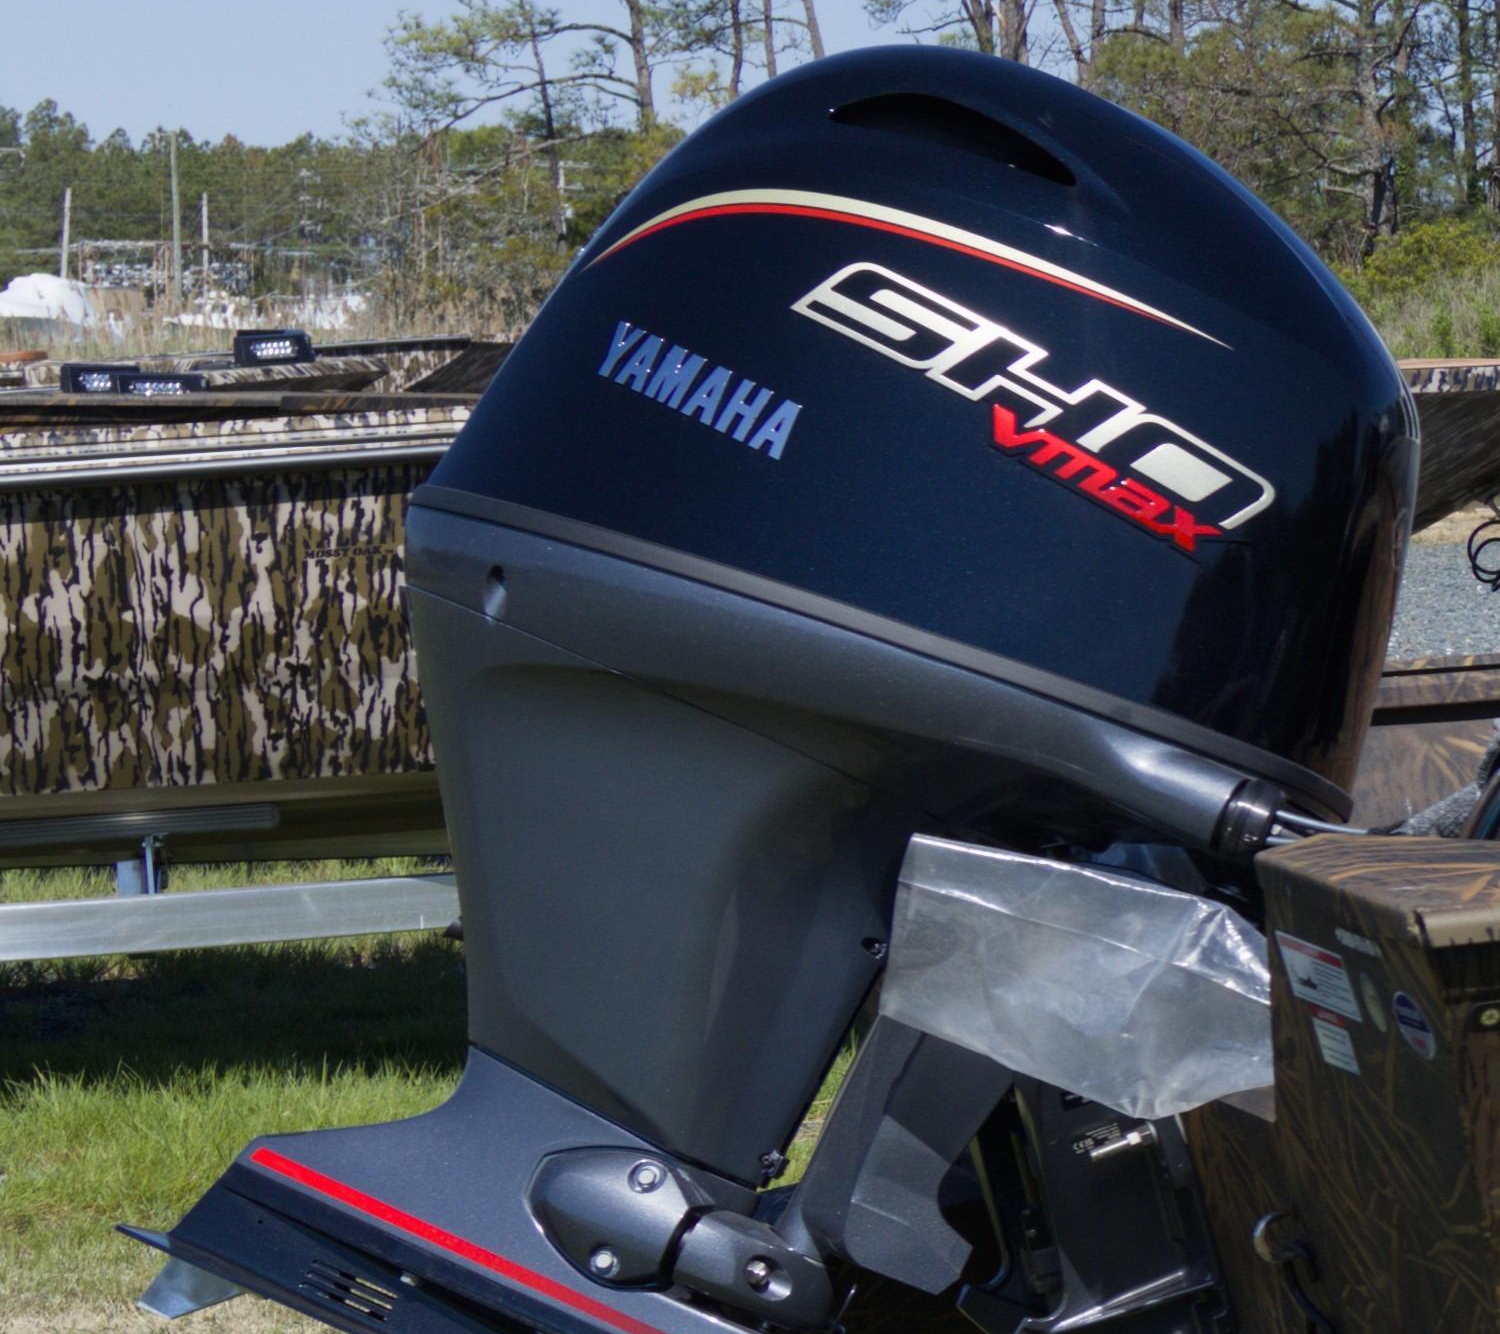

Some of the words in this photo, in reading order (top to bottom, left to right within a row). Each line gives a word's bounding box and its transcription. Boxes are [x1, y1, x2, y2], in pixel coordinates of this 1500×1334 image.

[597, 320, 803, 460] YAMAHA
[790, 262, 1276, 530] SHO
[304, 548, 349, 559] MOSSY
[353, 545, 382, 556] OAK
